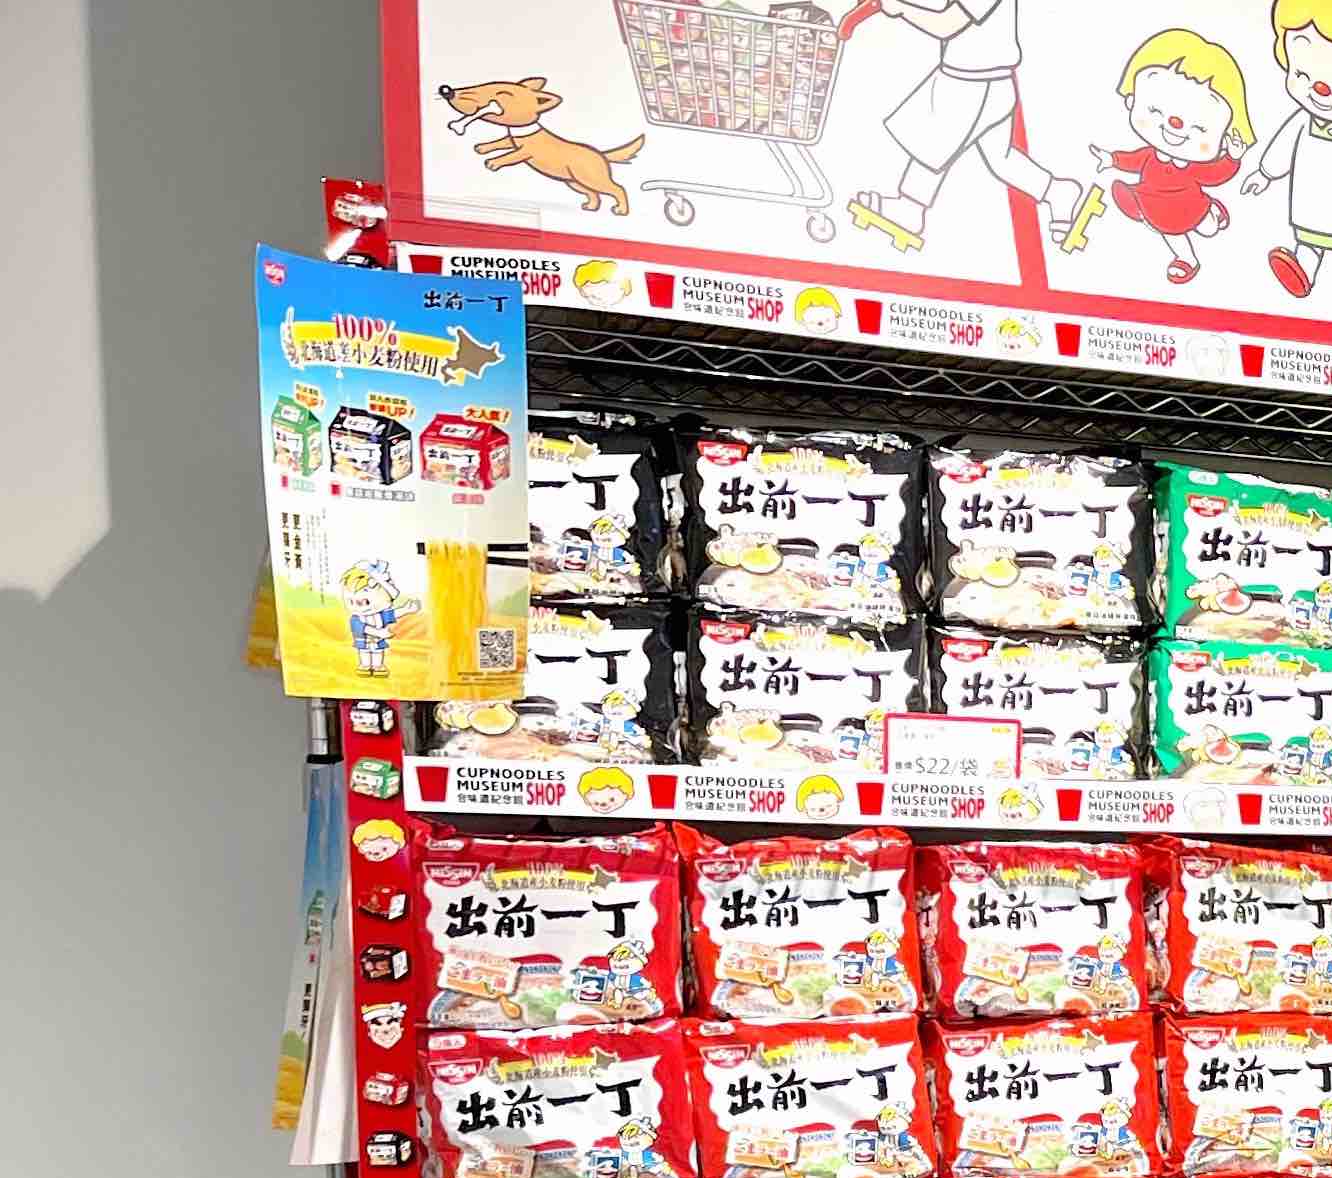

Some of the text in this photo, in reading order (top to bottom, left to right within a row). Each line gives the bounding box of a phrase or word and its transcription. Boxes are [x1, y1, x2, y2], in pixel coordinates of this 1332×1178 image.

[451, 256, 561, 274] CUPNOODLES
[521, 272, 561, 297] SHOP
[683, 277, 783, 298] CUPNOODLES
[424, 290, 509, 313] 出前一丁
[683, 290, 783, 323] MUSEUM SHOP
[889, 303, 983, 323] CUPNOODLES
[335, 314, 397, 346] 100%
[949, 323, 983, 347] SHOP
[1271, 360, 1321, 374] MUSEUM
[719, 476, 889, 529] 出前一丁
[961, 492, 1118, 539] 出前一丁
[721, 653, 891, 703] 出前一丁
[961, 670, 1119, 714] 出前一丁
[457, 767, 565, 781] CUPNOODLES
[685, 776, 785, 789] CUPNOODLES
[457, 780, 565, 806] MUSEUM SHOP
[749, 790, 784, 813] SHOP
[891, 782, 985, 796] CUPNOODLES
[950, 796, 985, 819] SHOP
[446, 893, 640, 939] 出前一丁
[719, 885, 888, 932] 出前一丁
[967, 890, 1116, 931] 出前一丁
[1199, 885, 1332, 927] 出前一丁
[728, 1063, 897, 1113] 出前一丁
[966, 1056, 1114, 1102] 出前一丁
[457, 1075, 642, 1135] 出前一丁
